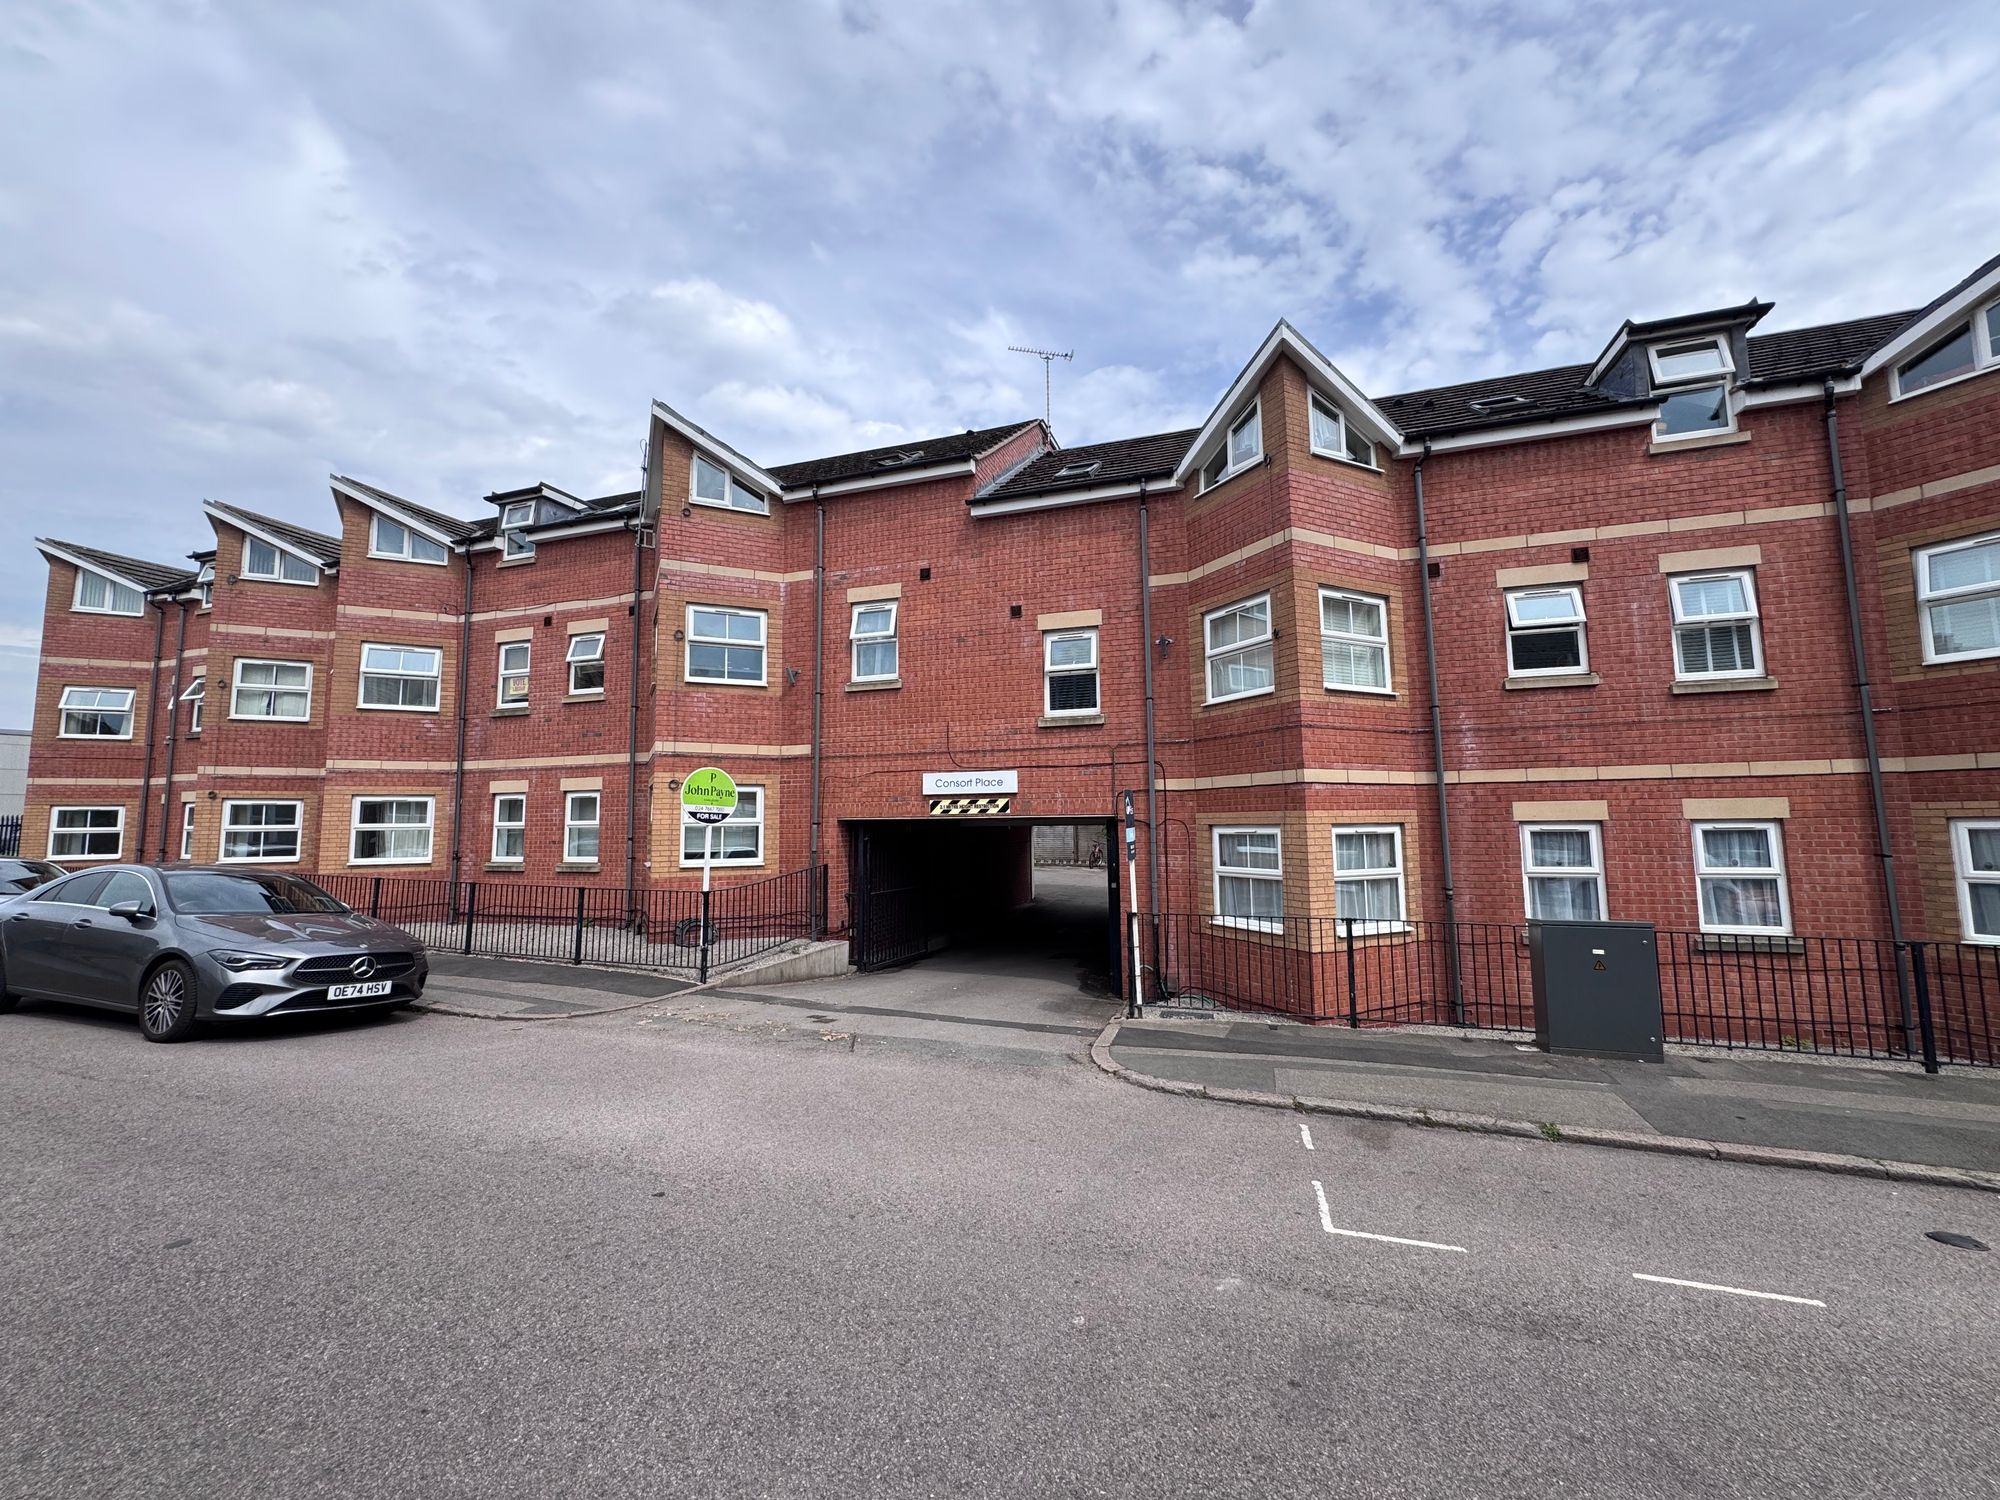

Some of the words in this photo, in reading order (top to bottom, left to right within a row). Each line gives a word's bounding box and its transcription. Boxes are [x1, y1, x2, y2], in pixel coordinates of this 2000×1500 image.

[935, 778, 972, 788] Consort
[976, 778, 1004, 786] Place
[334, 984, 364, 997] OE74
[366, 983, 387, 994] HSV
